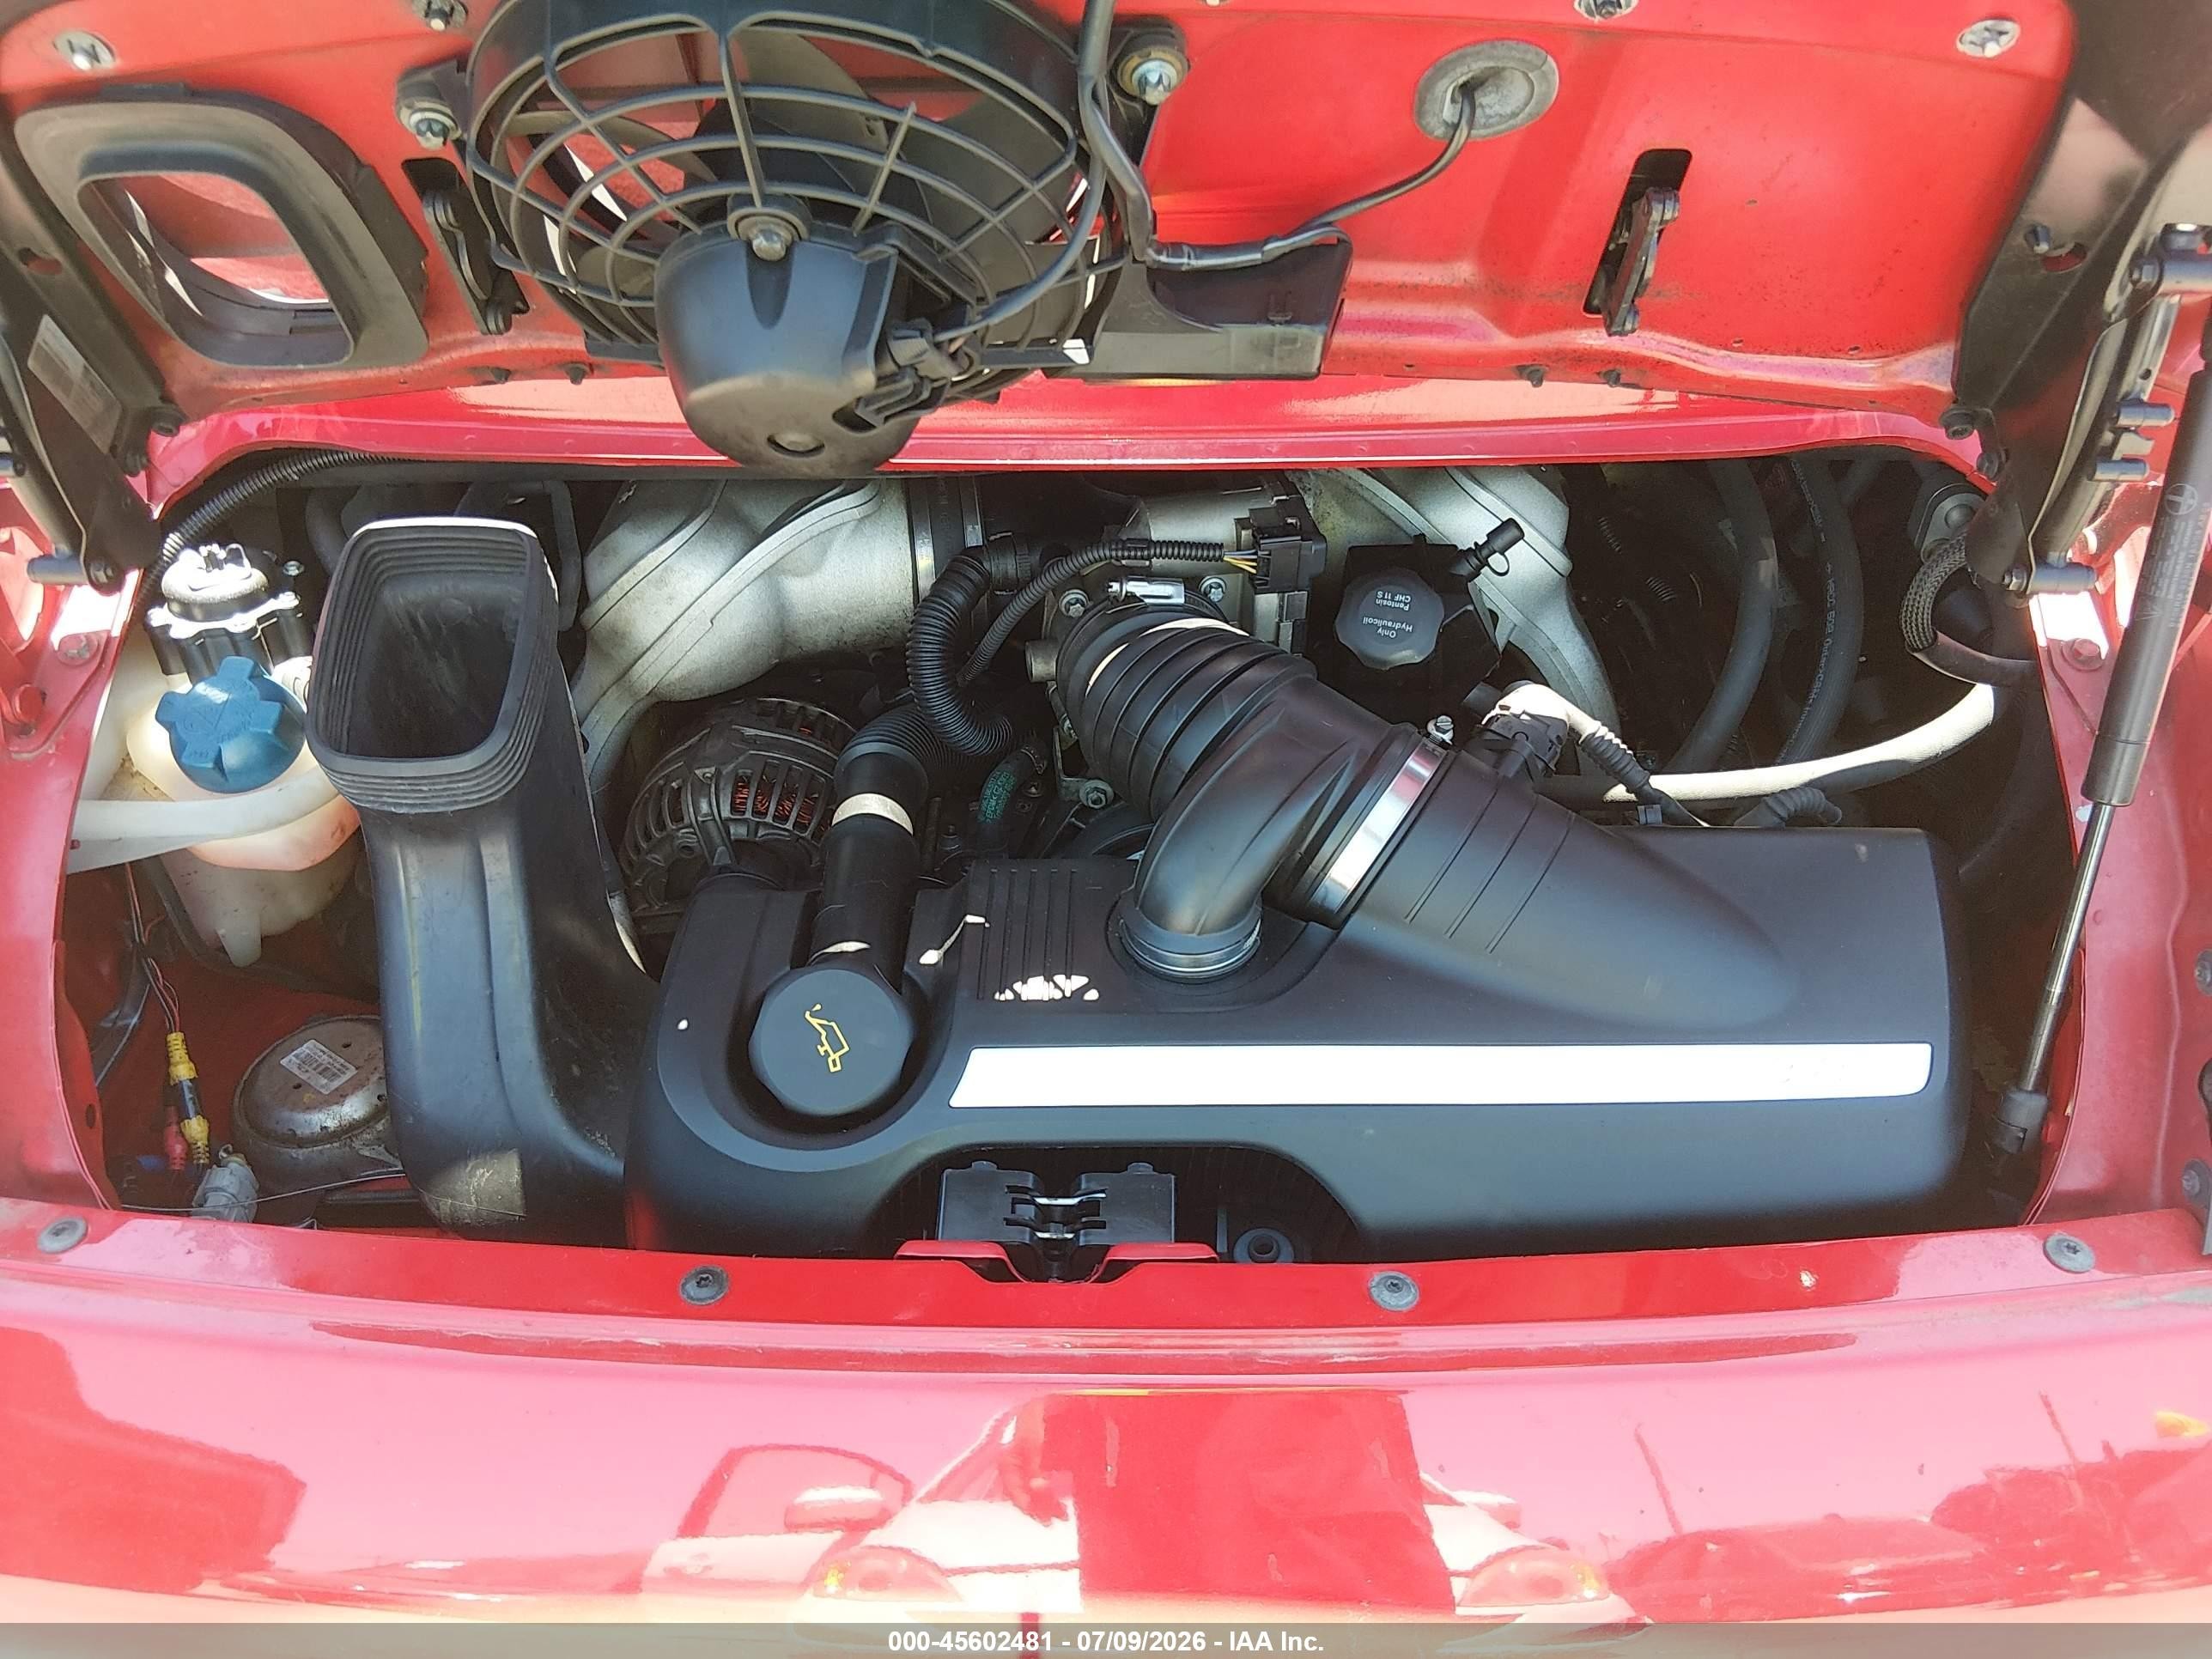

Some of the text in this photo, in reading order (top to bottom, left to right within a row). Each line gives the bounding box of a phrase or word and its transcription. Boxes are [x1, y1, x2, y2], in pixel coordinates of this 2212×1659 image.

[1394, 594, 1411, 603] CHF
[1376, 599, 1409, 611] Pentosin
[1363, 617, 1413, 632] Hydraulicoil
[1377, 628, 1396, 638] Only
